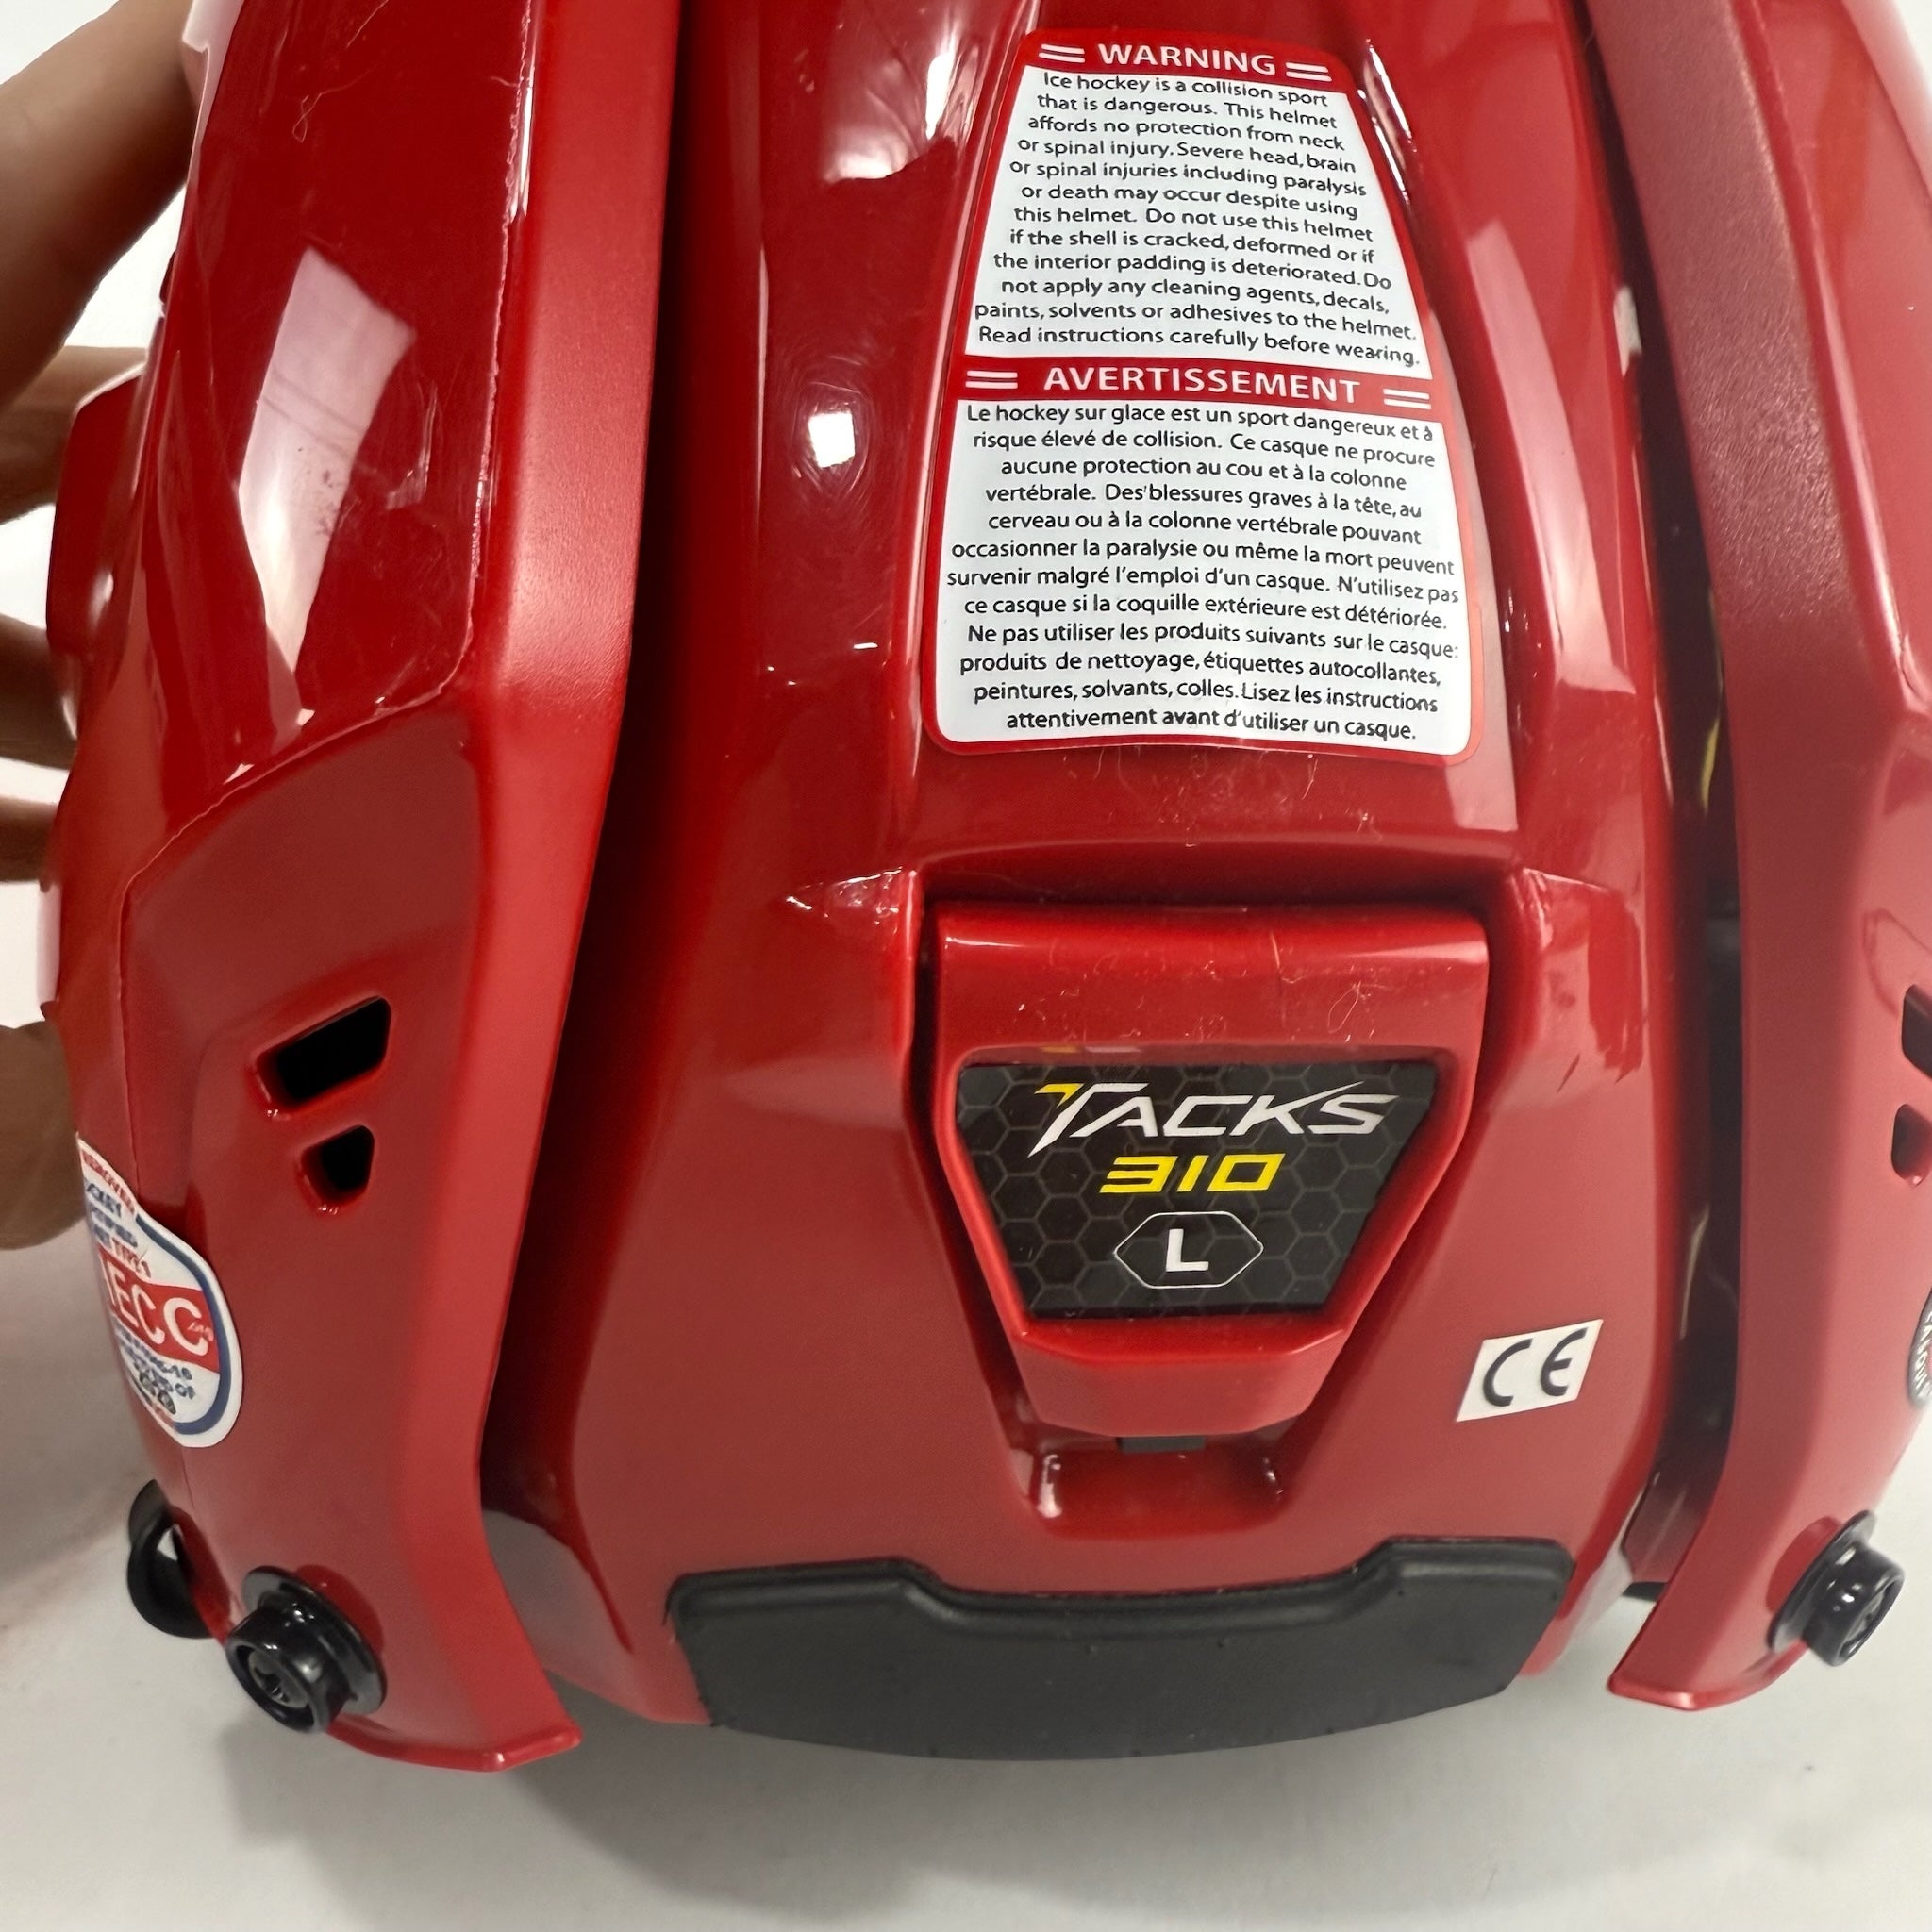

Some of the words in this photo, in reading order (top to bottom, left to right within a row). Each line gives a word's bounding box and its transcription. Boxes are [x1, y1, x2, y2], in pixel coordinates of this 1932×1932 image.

[1098, 43, 1276, 75] WARNING
[1044, 72, 1072, 88] Ice
[1077, 75, 1150, 93] hockey
[1156, 77, 1171, 91] is
[1175, 81, 1187, 92] a
[1192, 80, 1273, 100] collision
[1279, 91, 1329, 107] sport
[1037, 93, 1078, 110] that
[1083, 97, 1099, 111] is
[1104, 96, 1218, 115] dangerous.
[1224, 102, 1264, 120] This
[1269, 107, 1337, 129] helmet
[1028, 115, 1098, 133] affords
[1103, 122, 1130, 133] no
[1135, 122, 1241, 138] protection
[1246, 125, 1294, 143] from
[1299, 135, 1345, 151] neck
[1017, 139, 1040, 152] or
[1043, 140, 1105, 158] spinal
[1110, 141, 1174, 159] injury.
[1176, 142, 1244, 160] Severe
[1249, 147, 1304, 168] head,
[1307, 153, 1356, 173] brain
[1009, 161, 1031, 175] or
[1036, 161, 1097, 180] spinal
[1103, 162, 1178, 180] injuries
[1183, 164, 1277, 189] including
[1283, 176, 1367, 196] paralysis
[1021, 187, 1043, 199] or
[1047, 184, 1108, 199] death
[1113, 189, 1158, 204] may
[1162, 189, 1222, 203] occur
[1225, 190, 1300, 210] despite
[1305, 200, 1357, 221] using
[1013, 206, 1052, 223] this
[1057, 207, 1138, 223] helmet.
[1145, 208, 1176, 224] Do
[1181, 212, 1218, 225] not
[1222, 215, 1257, 228] use
[1261, 215, 1299, 232] this
[1304, 219, 1373, 242] helmet
[1010, 228, 1024, 244] if
[1027, 230, 1063, 245] the
[1069, 230, 1117, 245] shell
[1123, 231, 1139, 246] is
[1143, 232, 1229, 251] cracked,
[1232, 235, 1331, 258] deformed
[1337, 250, 1357, 262] or
[1362, 249, 1374, 264] if
[993, 252, 1028, 270] the
[1034, 254, 1112, 270] interior
[1117, 254, 1206, 275] padding
[1211, 257, 1227, 273] is
[1231, 258, 1361, 286] deteriorated.
[1363, 272, 1391, 290] Do
[1002, 280, 1038, 293] not
[1042, 277, 1103, 297] apply
[1108, 281, 1146, 298] any
[1151, 278, 1241, 301] cleaning
[1246, 287, 1320, 307] agents,
[1323, 291, 1389, 314] decals,
[974, 302, 1045, 321] paints,
[1048, 302, 1137, 318] solvents
[1141, 307, 1164, 318] or
[1169, 304, 1273, 325] adhesives
[1276, 312, 1298, 326] to
[1303, 312, 1337, 331] the
[1342, 316, 1416, 340] helmet.
[979, 325, 1031, 343] Read
[1037, 326, 1164, 343] instructions
[1169, 328, 1259, 352] carefully
[1264, 332, 1330, 355] before
[1335, 344, 1419, 368] wearing.
[1043, 366, 1360, 404] AVERTISSEMENT
[967, 405, 991, 422] Le
[996, 404, 1070, 425] hockey
[1075, 408, 1107, 421] sur
[1111, 403, 1165, 425] glace
[1171, 408, 1201, 422] est
[1206, 409, 1232, 423] un
[1238, 410, 1289, 427] sport
[1293, 412, 1396, 437] dangereux
[974, 431, 1037, 452] risque
[1041, 429, 1096, 447] élevé
[1133, 430, 1223, 449] collision.
[1230, 433, 1256, 450] Ce
[1260, 440, 1329, 458] casque
[1335, 446, 1358, 459] ne
[1363, 449, 1435, 467] procure
[1001, 460, 1078, 475] aucune
[1083, 457, 1191, 478] protection
[1225, 463, 1263, 477] cou
[1330, 468, 1407, 491] colonne
[985, 483, 1096, 502] vertébrale.
[1105, 483, 1144, 501] Des
[1149, 483, 1243, 503] blessures
[1248, 491, 1312, 508] graves
[1354, 496, 1396, 518] tête,
[988, 515, 1070, 529] cerveau
[1148, 510, 1232, 530] colonne
[1236, 516, 1338, 537] vertébrale
[1342, 525, 1422, 545] pouvant
[952, 539, 1078, 558] occasionner
[1106, 538, 1198, 561] paralysie
[1235, 541, 1299, 561] même
[1325, 552, 1373, 568] mort
[1378, 557, 1454, 575] peuvent
[947, 567, 1032, 586] survenir
[1037, 566, 1110, 589] malgré
[1255, 575, 1330, 593] casque.
[1428, 589, 1458, 605] pas
[992, 599, 1067, 618] casque
[1072, 594, 1087, 612] si
[1116, 593, 1200, 616] coquille
[1205, 597, 1307, 618] extérieure
[1311, 605, 1341, 620] est
[1345, 604, 1446, 629] détériorée.
[968, 625, 997, 642] Ne
[1002, 628, 1039, 646] pas
[1044, 622, 1115, 641] utiliser
[1120, 622, 1149, 641] les
[1155, 622, 1241, 643] produits
[1245, 626, 1326, 647] suivants
[1333, 635, 1363, 650] sur
[1368, 633, 1384, 652] le
[960, 652, 1047, 676] produits
[1055, 651, 1082, 670] de
[1088, 653, 1200, 673] nettoyage,
[1203, 651, 1304, 675] étiquettes
[1309, 661, 1441, 687] autocollantes,
[974, 681, 1078, 705] peintures,
[1081, 679, 1173, 699] solvants,
[1176, 678, 1239, 698] colles.
[1241, 682, 1291, 702] Lisez
[1294, 684, 1322, 704] les
[1326, 687, 1438, 712] instructions
[1007, 708, 1158, 729] attentivement
[1162, 710, 1220, 726] avant
[1313, 720, 1340, 734] un
[1344, 722, 1416, 741] casque.
[1027, 1081, 1399, 1158] TACKS
[1099, 1152, 1286, 1194] 310
[1166, 1228, 1209, 1272] L
[1482, 1327, 1589, 1407] CE
